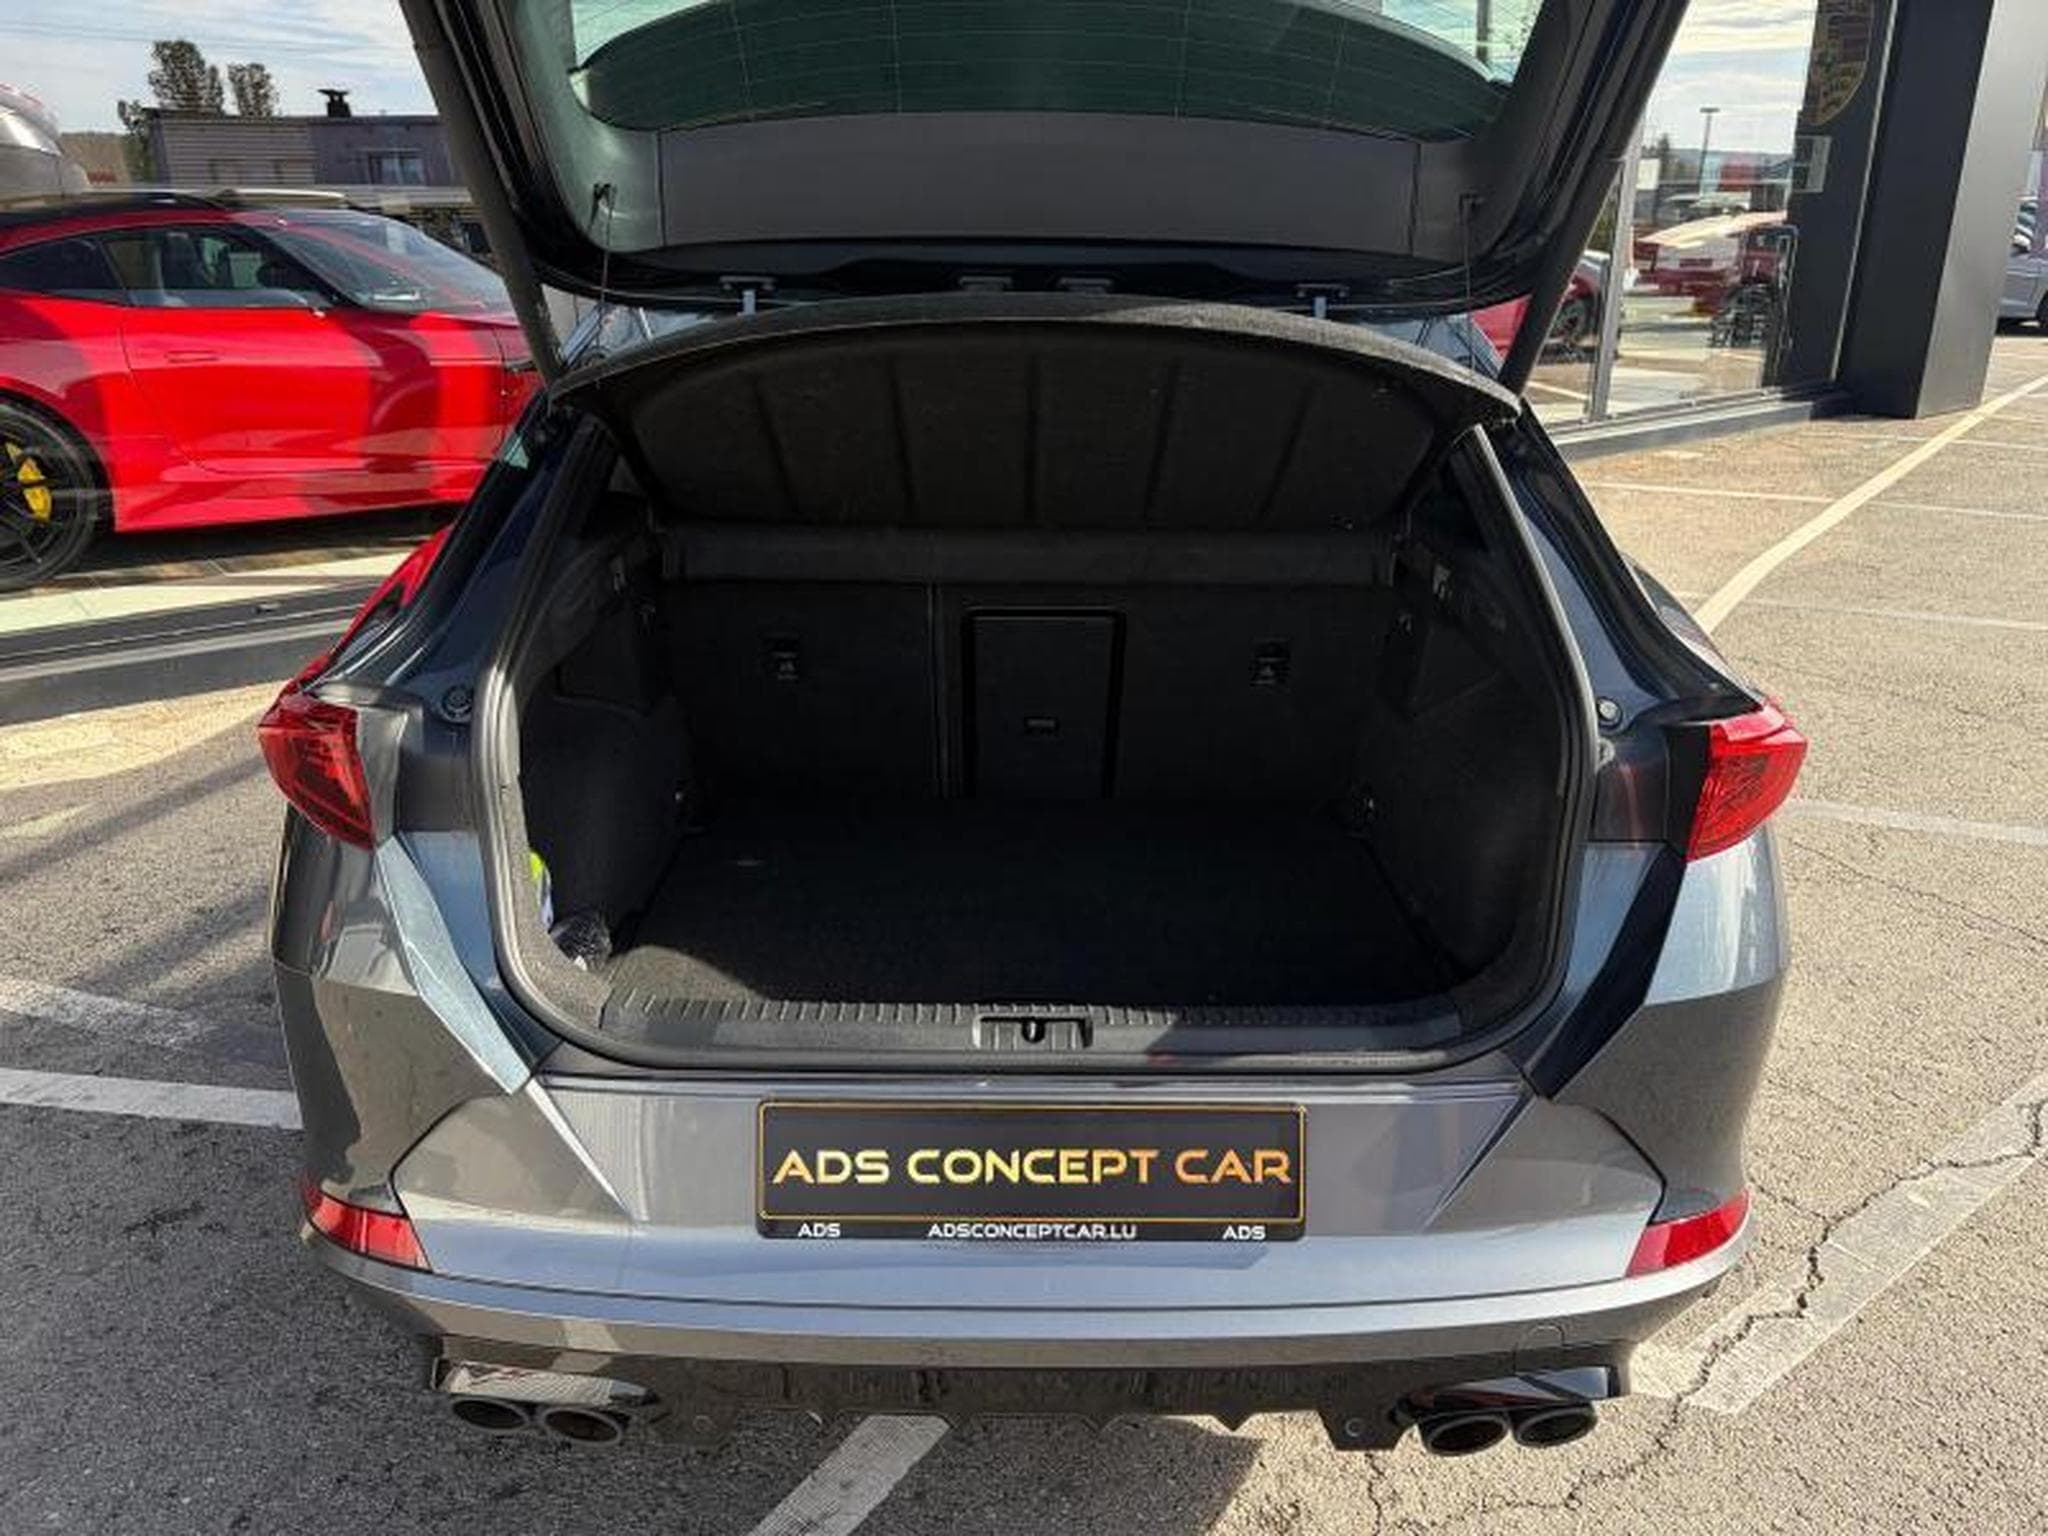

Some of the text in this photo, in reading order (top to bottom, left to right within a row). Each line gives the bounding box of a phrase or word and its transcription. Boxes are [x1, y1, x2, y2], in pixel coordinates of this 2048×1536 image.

[772, 1149, 1292, 1184] ADS CONCEPT CAR
[797, 1223, 1266, 1241] ADS ADSCONCEPTCAR.LU ADS
